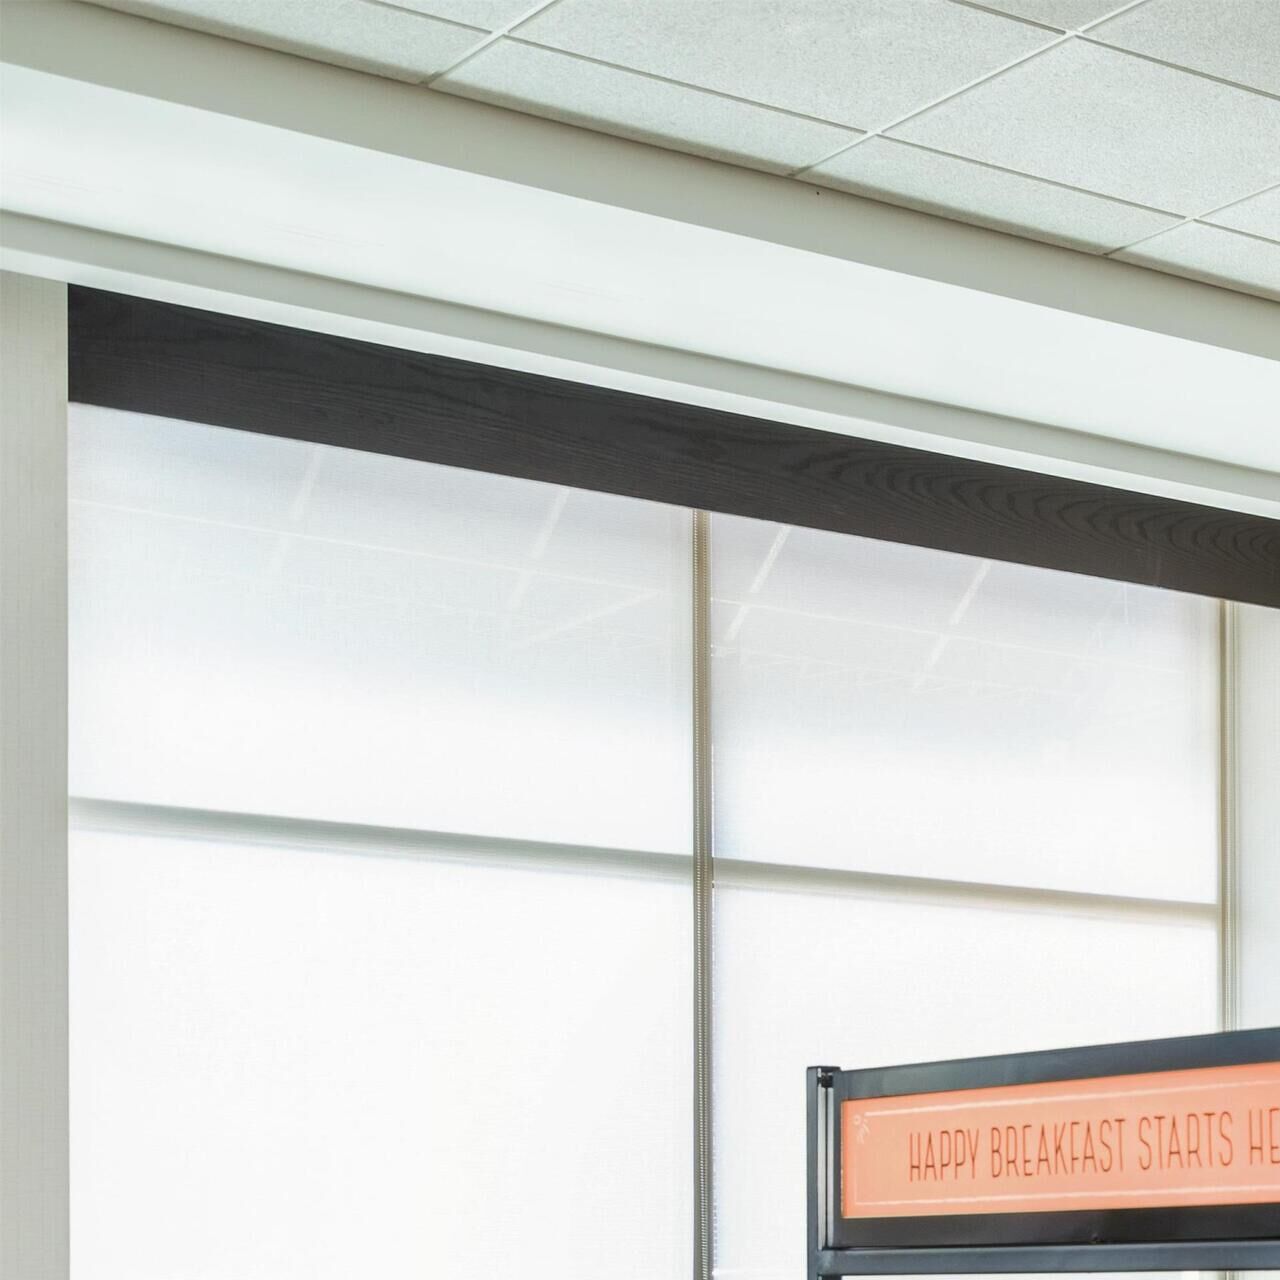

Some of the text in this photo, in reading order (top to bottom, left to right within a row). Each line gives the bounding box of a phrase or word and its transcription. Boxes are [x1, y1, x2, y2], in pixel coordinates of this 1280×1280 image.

[908, 1128, 980, 1183] HAPPY
[990, 1118, 1127, 1178] BREAKFAST
[1138, 1111, 1235, 1171] STARTS
